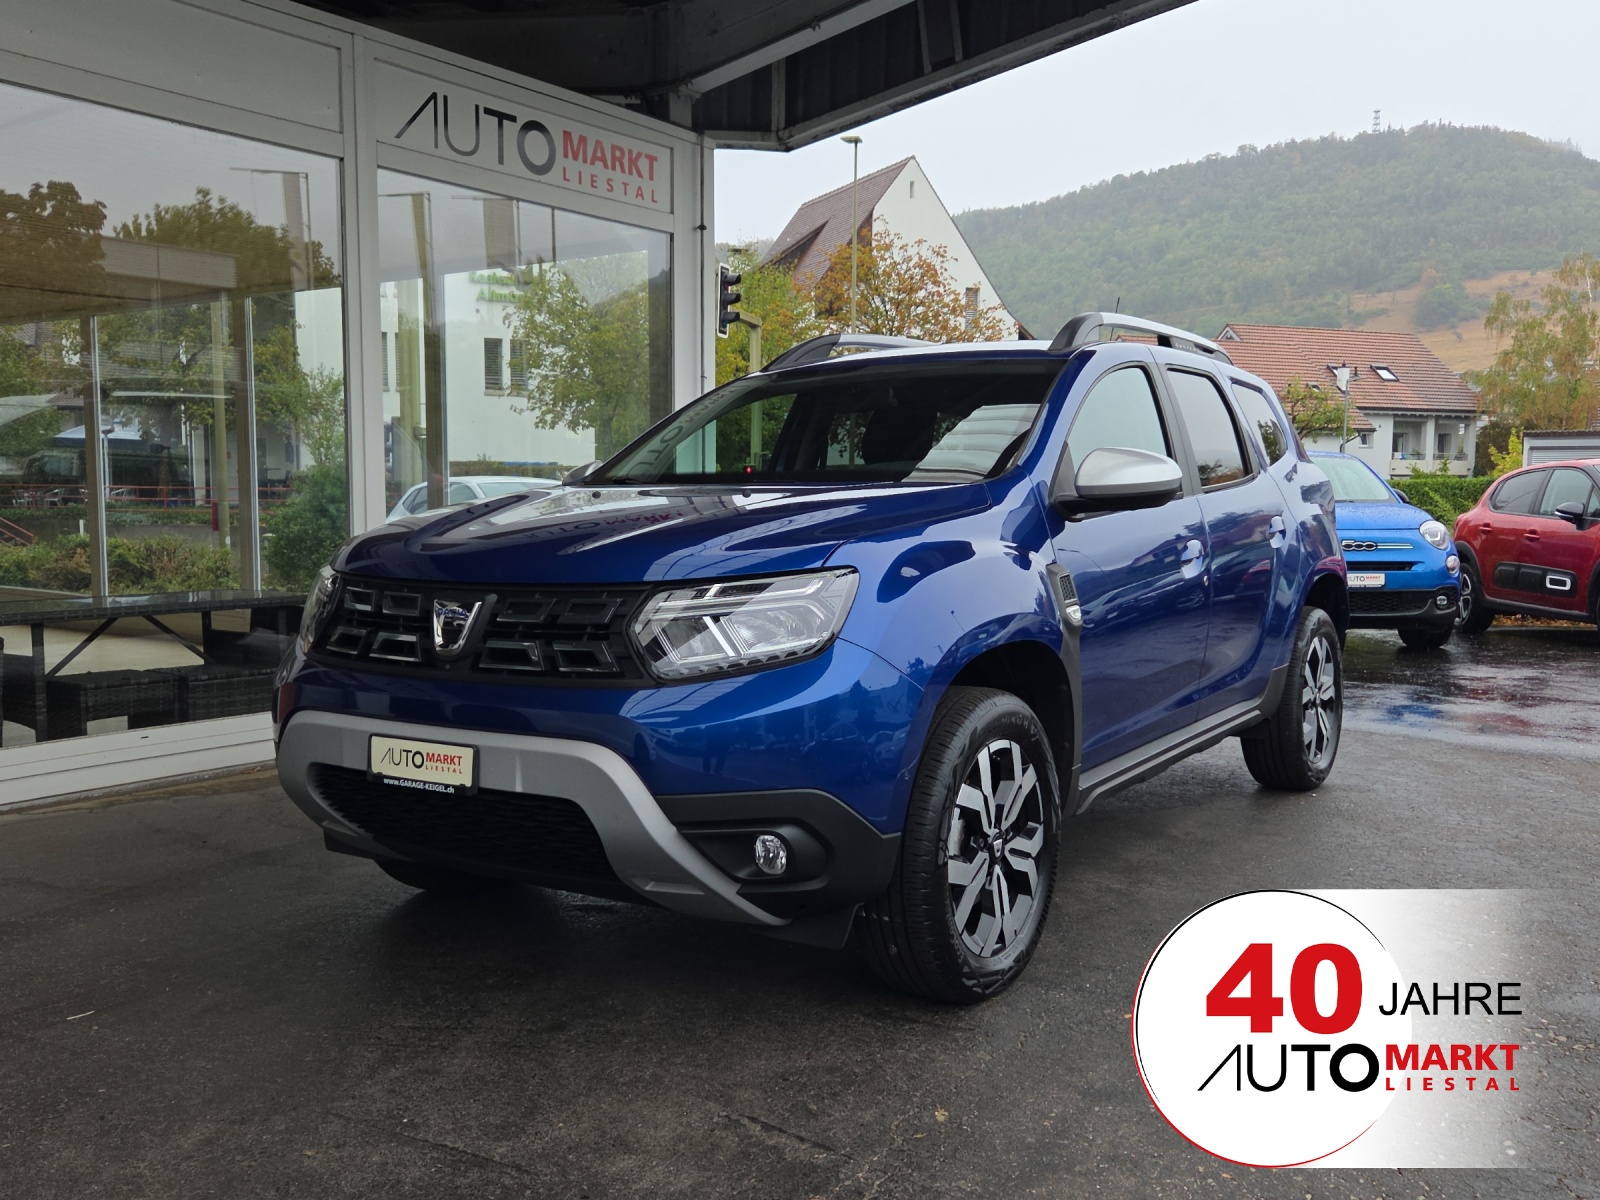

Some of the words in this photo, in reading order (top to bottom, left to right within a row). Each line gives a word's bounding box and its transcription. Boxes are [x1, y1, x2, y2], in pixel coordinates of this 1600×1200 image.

[394, 92, 557, 176] AUTO
[562, 129, 659, 182] MARKT
[562, 167, 658, 203] LIESTAL
[1341, 540, 1378, 551] 500
[380, 747, 425, 769] AUTO
[425, 752, 463, 767] MARKT
[425, 765, 463, 774] LIESTAL
[383, 778, 455, 794] www.GARAGE-KEIGEL.ch
